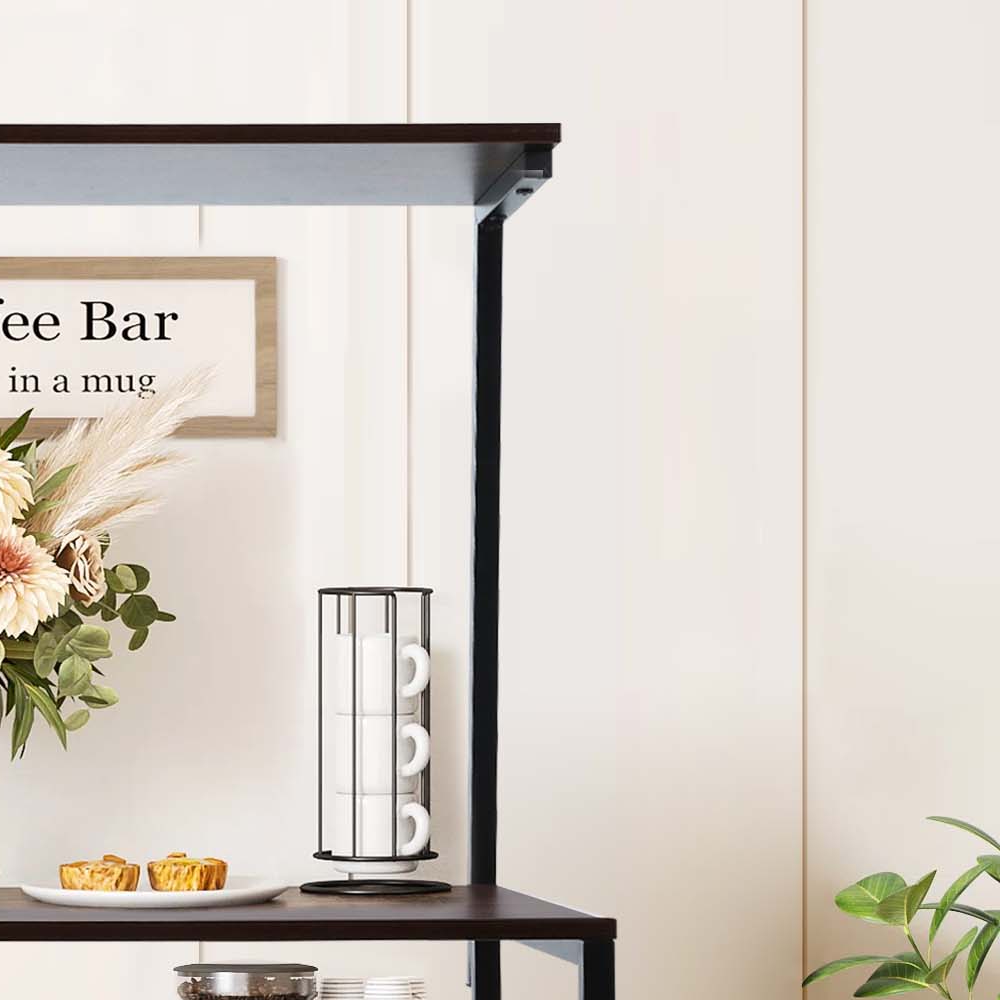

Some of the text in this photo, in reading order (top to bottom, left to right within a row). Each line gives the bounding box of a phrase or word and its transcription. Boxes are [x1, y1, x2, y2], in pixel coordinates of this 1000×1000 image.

[80, 301, 179, 342] Bar
[9, 366, 41, 393] in
[52, 374, 70, 393] a
[81, 374, 157, 400] mug
